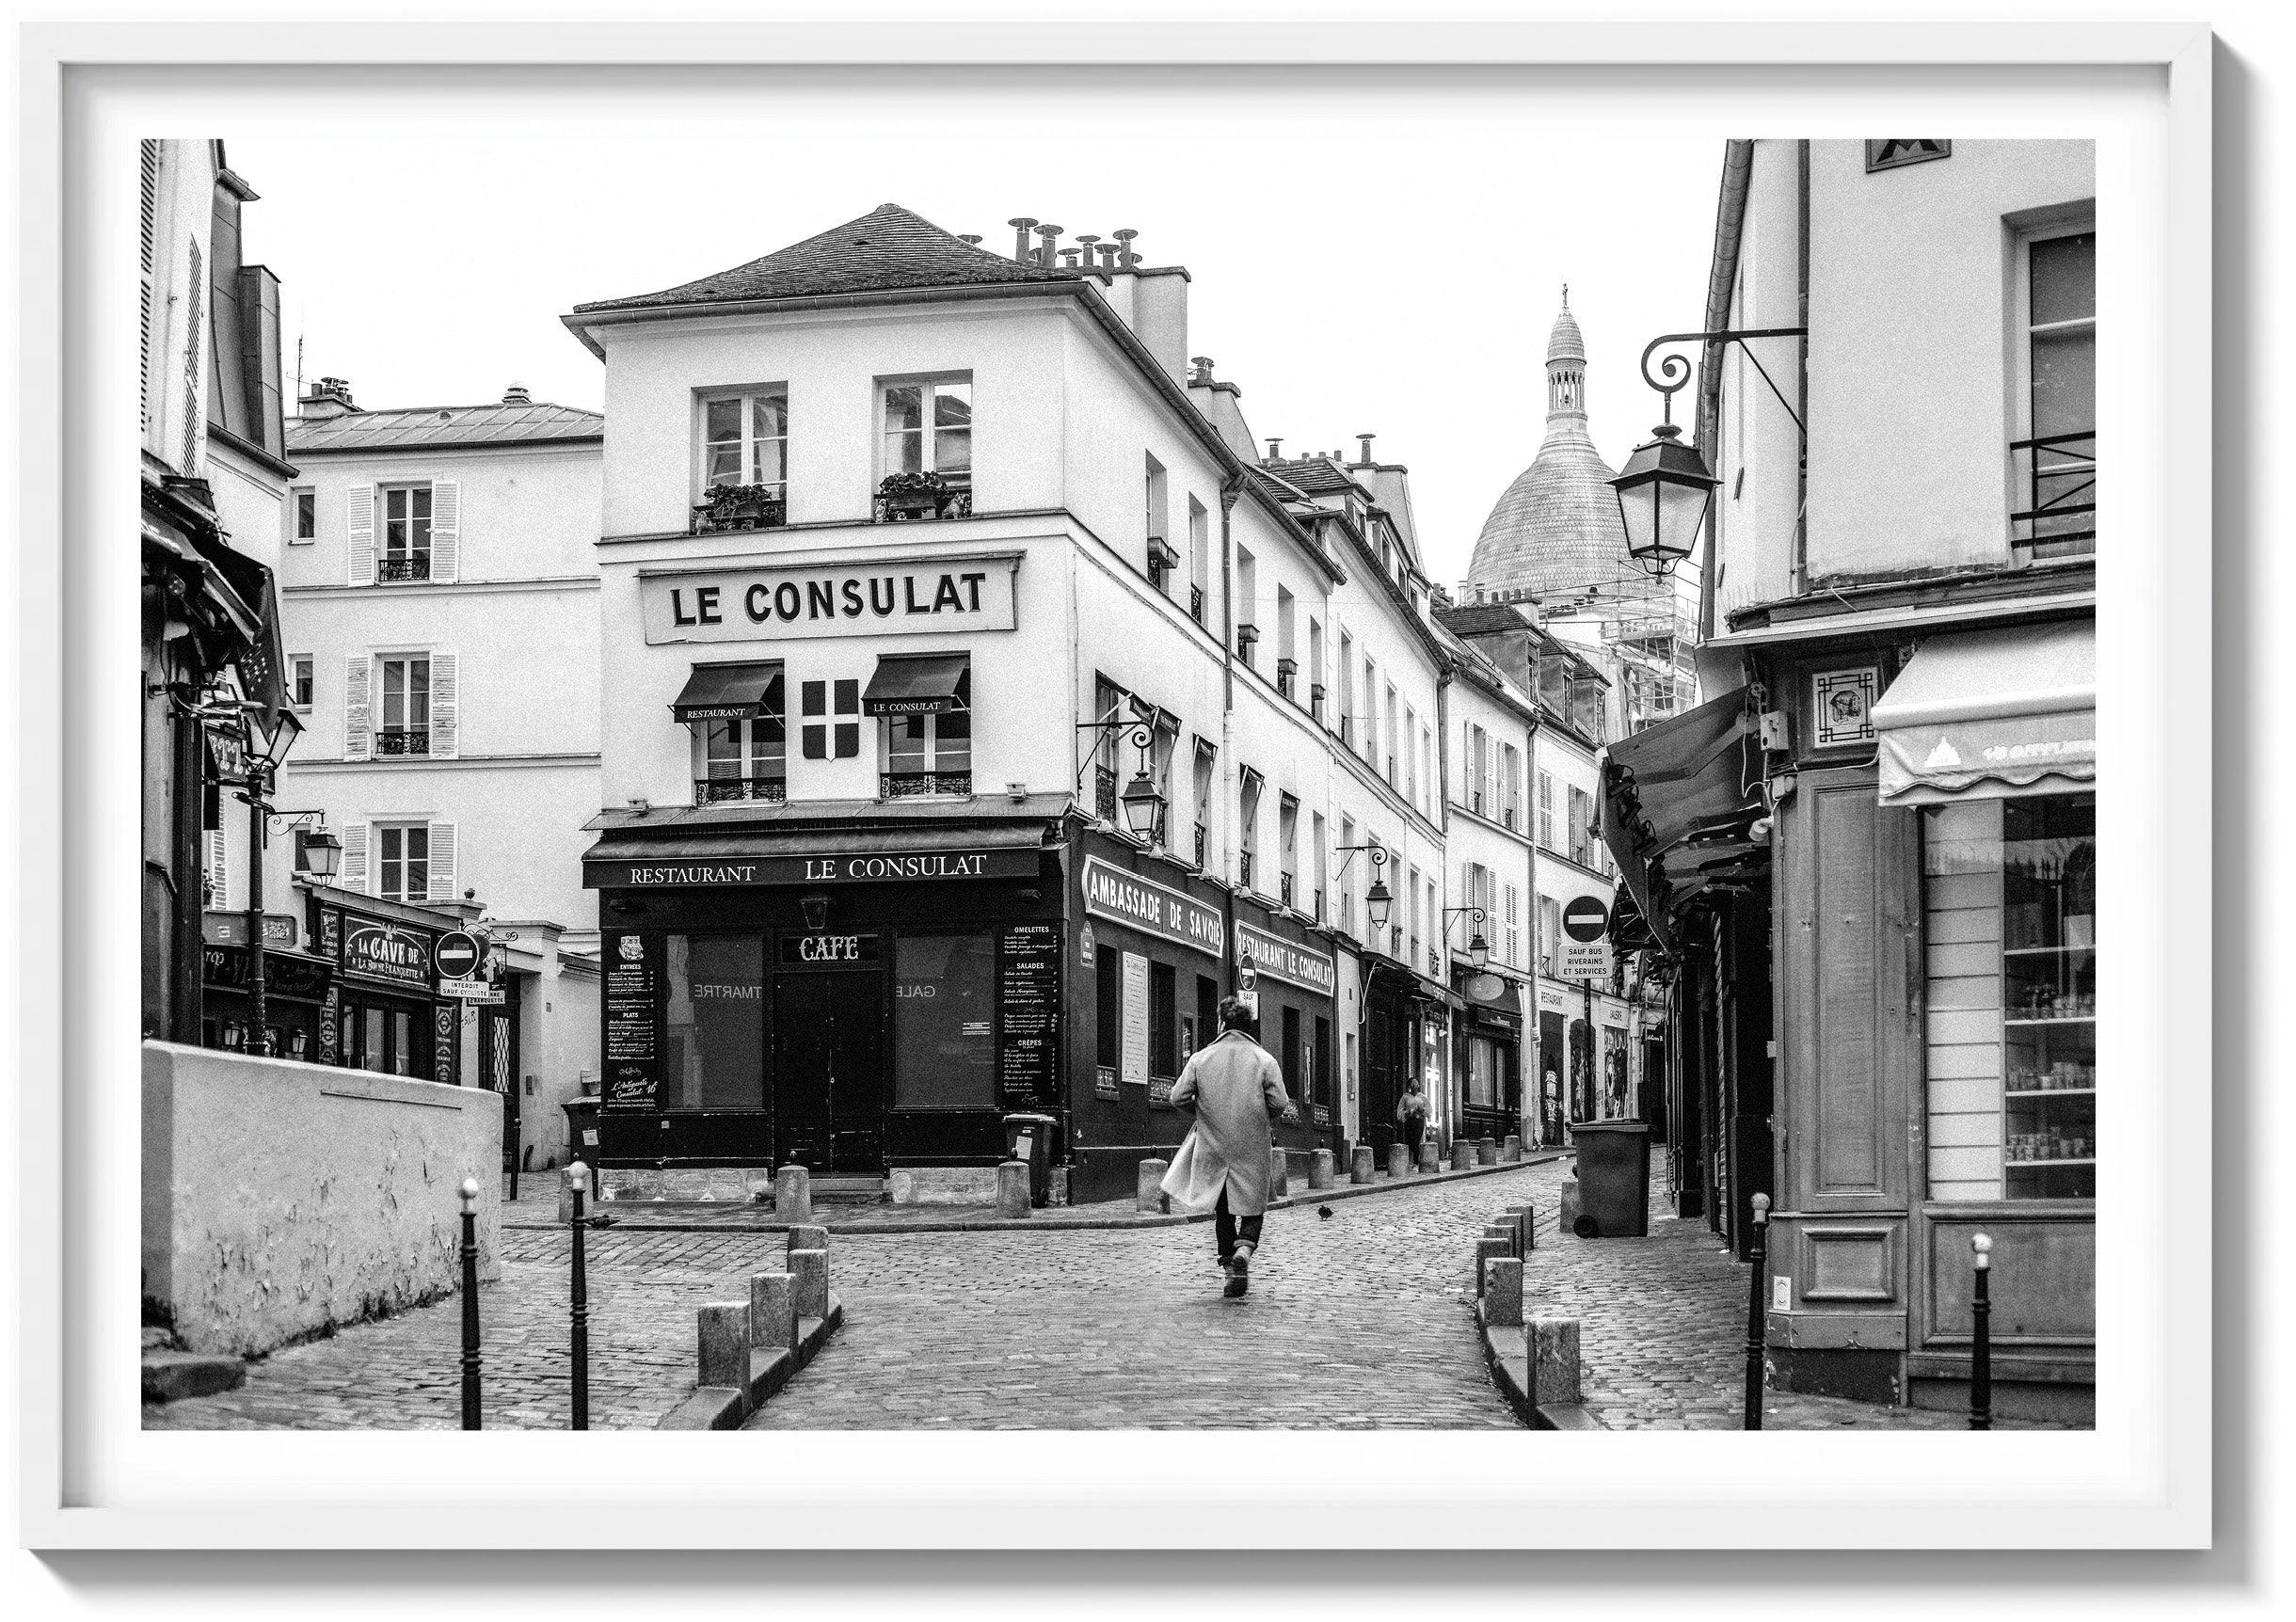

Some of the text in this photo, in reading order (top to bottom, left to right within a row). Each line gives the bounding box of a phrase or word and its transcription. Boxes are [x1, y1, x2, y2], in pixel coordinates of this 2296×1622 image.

[670, 572, 987, 628] LE CONSULAT
[686, 707, 746, 720] RESTAURANT
[873, 700, 941, 713] LE CONSULAT
[630, 854, 988, 884] RESTAURANT LE CONSULAT
[1090, 870, 1220, 947] AMBASSADE DE SAVOIE
[359, 937, 369, 955] LA
[370, 937, 406, 965] CAVE
[407, 946, 419, 964] DE
[1236, 931, 1331, 988] RESTAURANT LE CONSULAT
[359, 958, 367, 970] LA
[385, 962, 419, 978] FRANQUETTE
[460, 989, 487, 997] CYCLISTE
